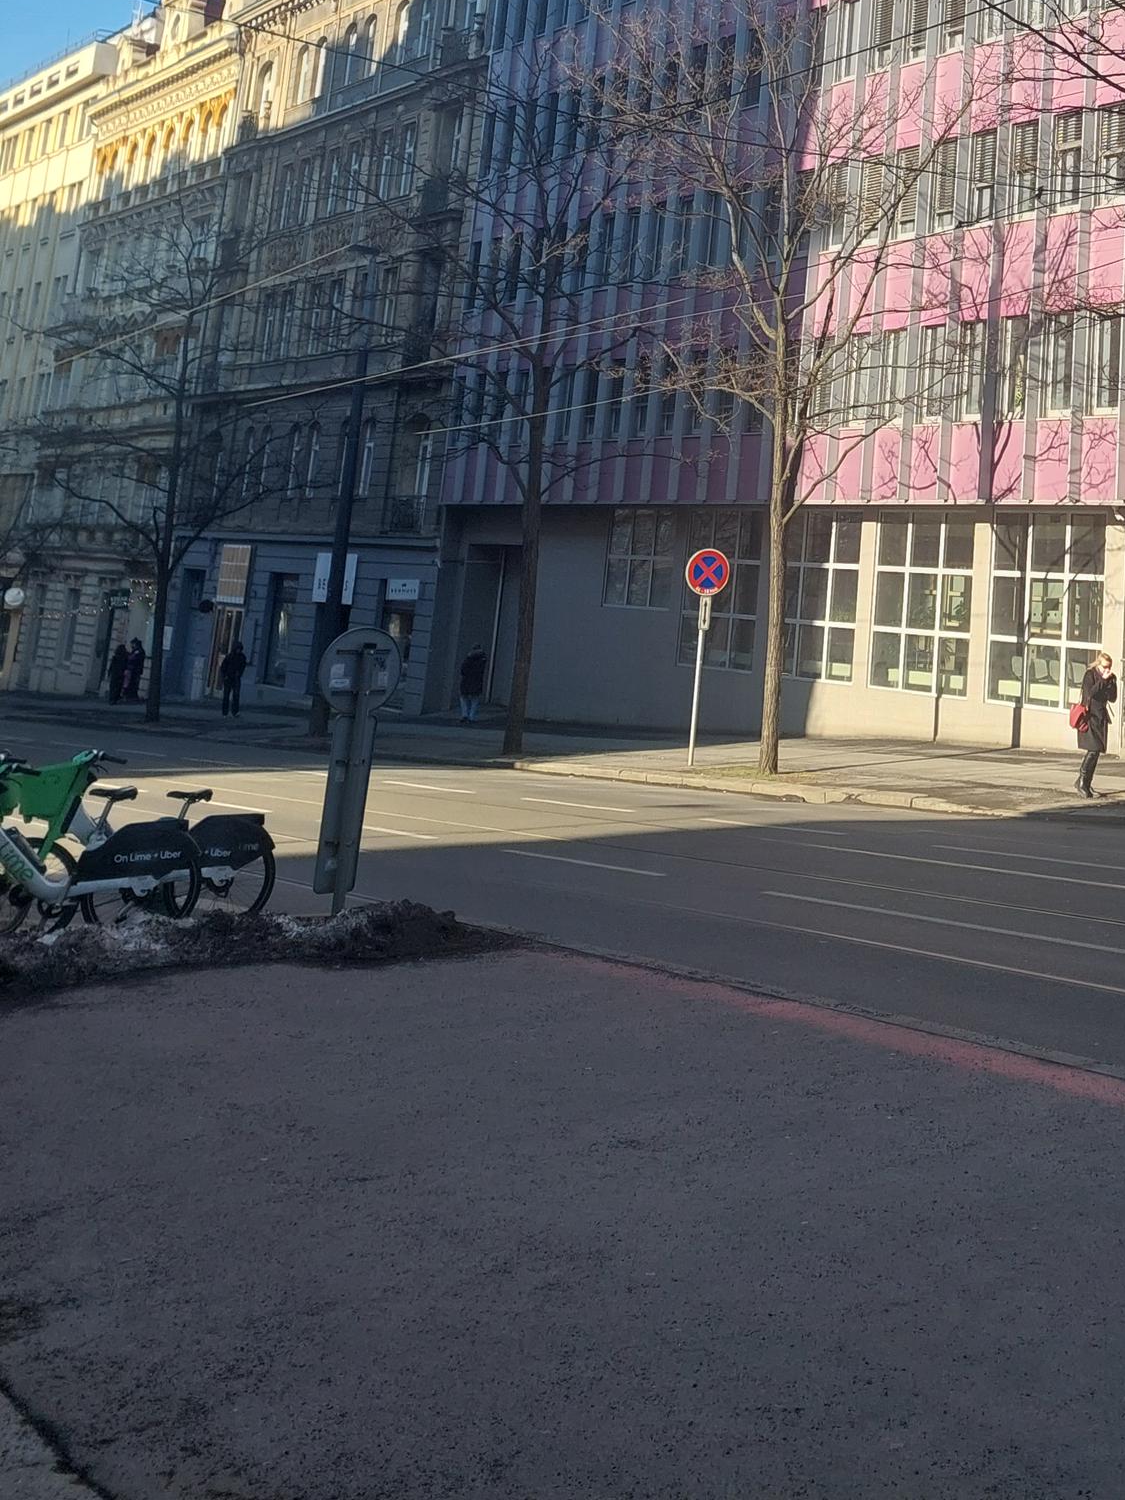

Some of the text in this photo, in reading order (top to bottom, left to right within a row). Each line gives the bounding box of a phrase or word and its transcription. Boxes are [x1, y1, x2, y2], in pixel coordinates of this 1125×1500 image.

[114, 854, 128, 863] On
[130, 852, 152, 862] Lime
[160, 851, 181, 859] Uber
[210, 848, 231, 857] Uber
